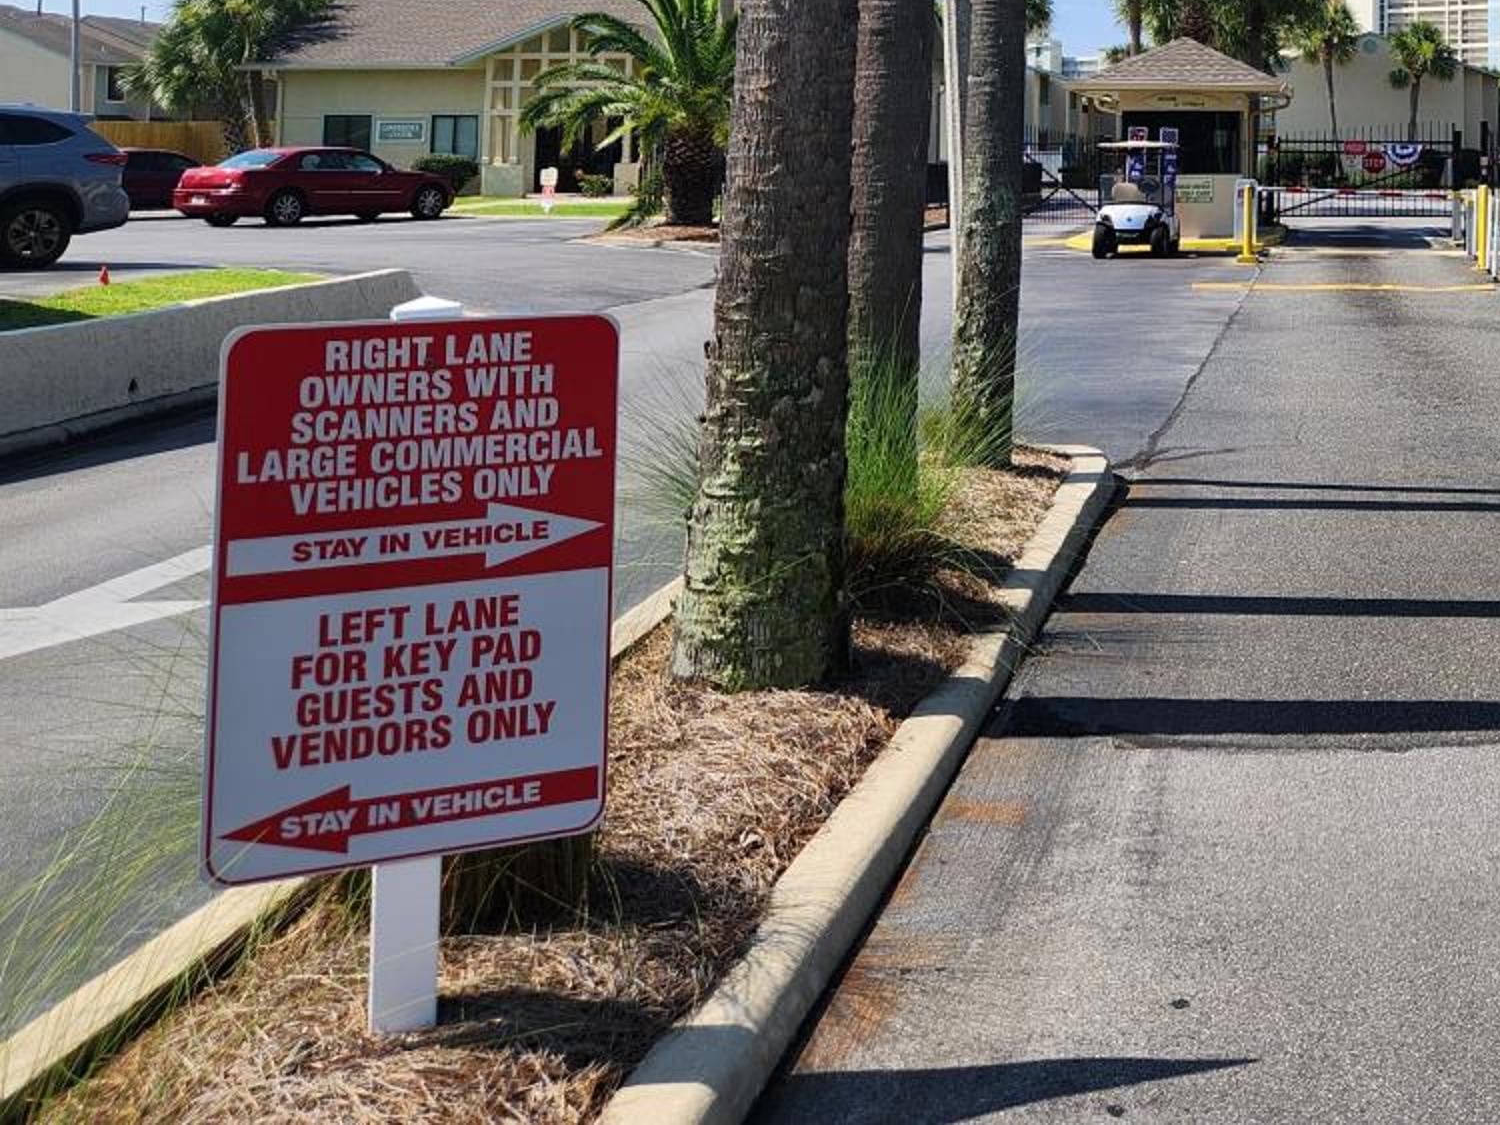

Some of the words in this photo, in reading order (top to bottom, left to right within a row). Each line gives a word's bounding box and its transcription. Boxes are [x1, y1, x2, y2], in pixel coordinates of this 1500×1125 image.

[1363, 158, 1385, 168] STOP
[325, 336, 434, 372] RIGHT
[445, 331, 532, 366] LANE
[299, 367, 452, 409] OWNERS
[464, 363, 554, 399] WITH
[291, 403, 478, 445] SCANNERS
[491, 398, 560, 429] AND
[237, 443, 356, 484] LARGE
[370, 427, 603, 474] COMMERCIAL
[290, 471, 462, 516] VEHICLES
[473, 465, 556, 501] ONLY
[291, 536, 368, 562] STAY
[379, 532, 410, 553] IN
[422, 520, 550, 549] VEHICLE
[318, 605, 411, 647] LEFT
[425, 594, 520, 635] LANE
[291, 652, 366, 690] FOR
[383, 639, 458, 679] KEY
[470, 630, 543, 668] PAD
[296, 678, 443, 728] GUESTS
[458, 668, 533, 707] AND
[271, 717, 452, 771] VENDORS
[467, 701, 557, 743] ONLY
[280, 807, 357, 840] STAY
[367, 802, 400, 825] IN
[410, 781, 542, 819] VEHICLE
